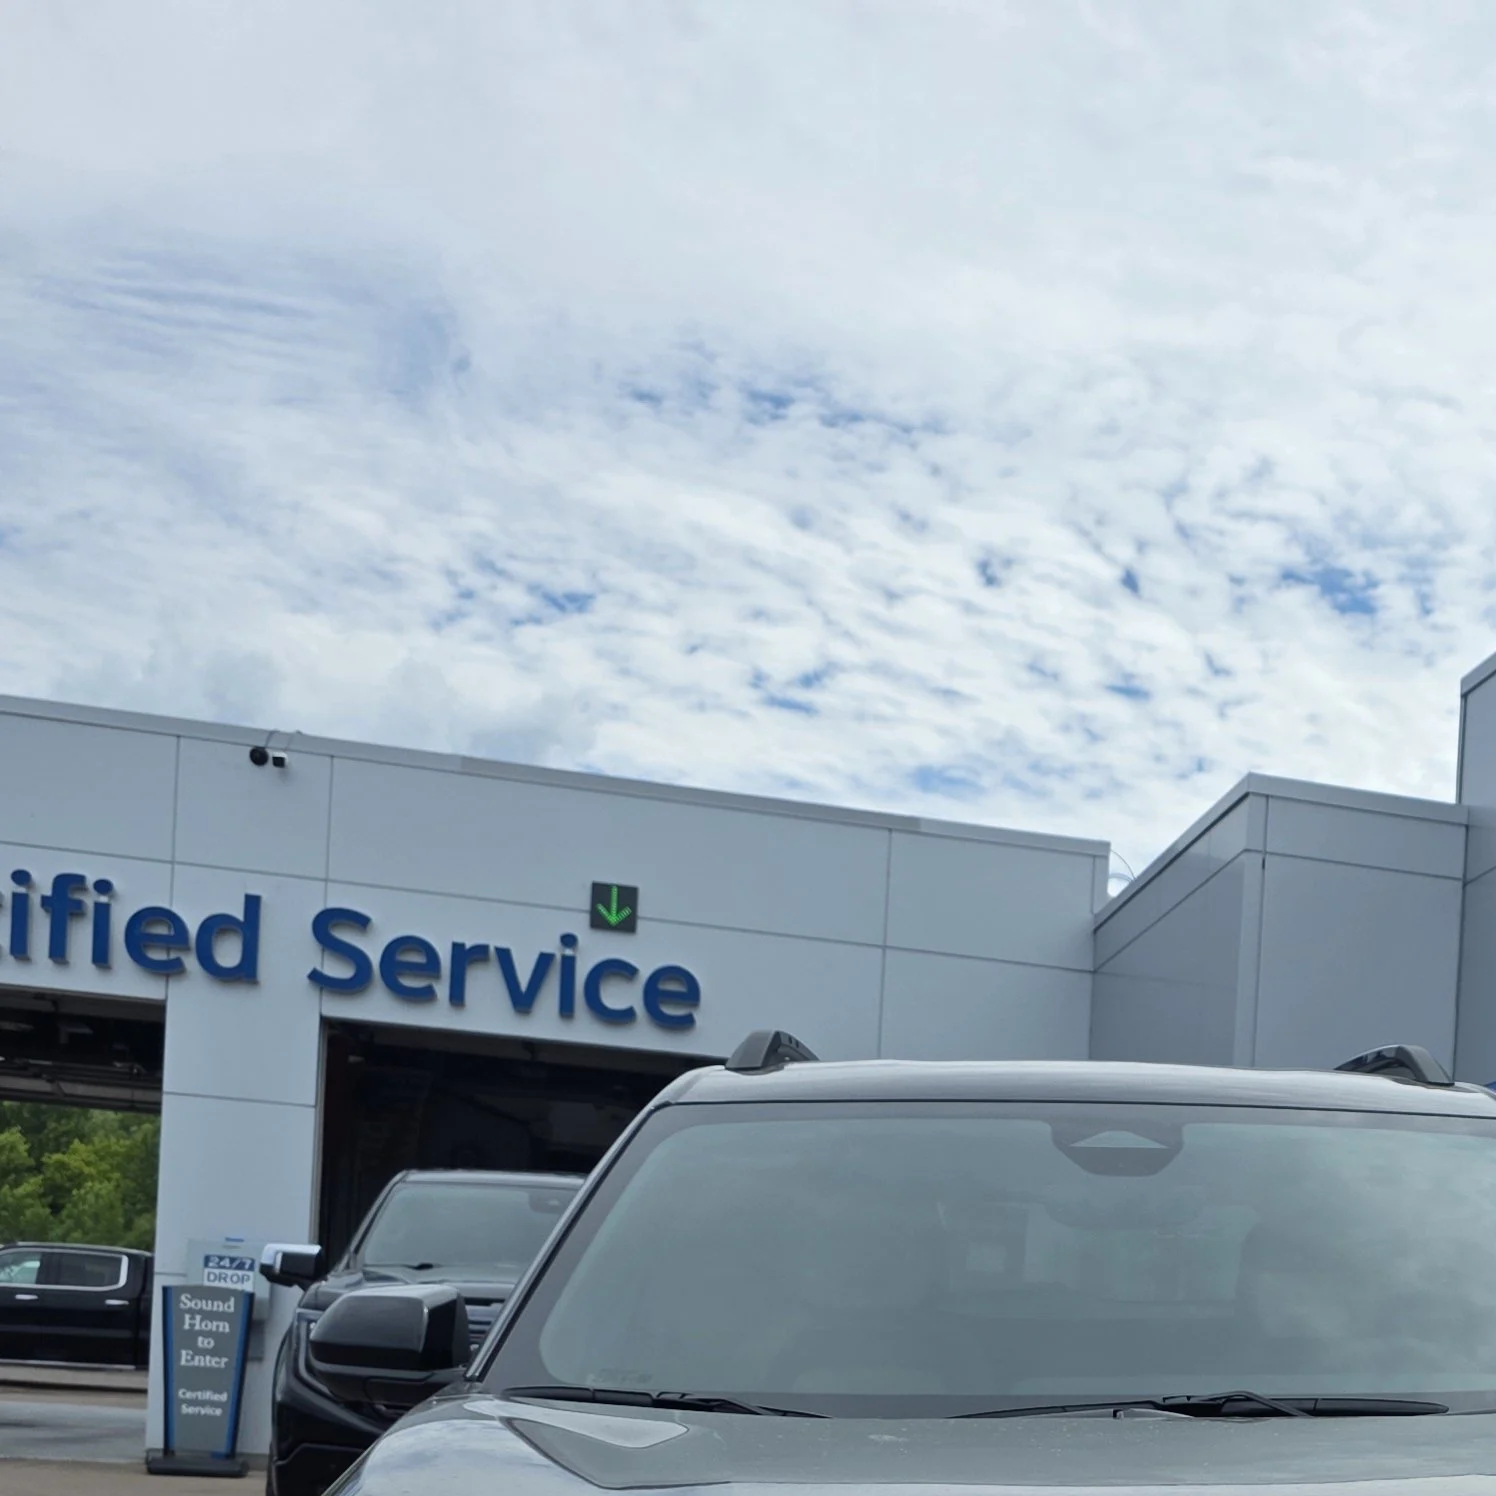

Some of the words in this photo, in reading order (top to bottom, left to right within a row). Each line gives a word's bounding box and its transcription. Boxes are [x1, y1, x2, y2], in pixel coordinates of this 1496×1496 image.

[0, 868, 262, 985] ified
[308, 907, 702, 1030] Service
[208, 1256, 252, 1270] 24/7
[207, 1271, 251, 1285] DROP
[179, 1293, 235, 1312] Sound
[183, 1313, 230, 1333] Horn
[197, 1335, 215, 1349] to
[180, 1349, 229, 1368] Enter
[178, 1388, 228, 1402] Certified
[181, 1403, 223, 1416] Service
